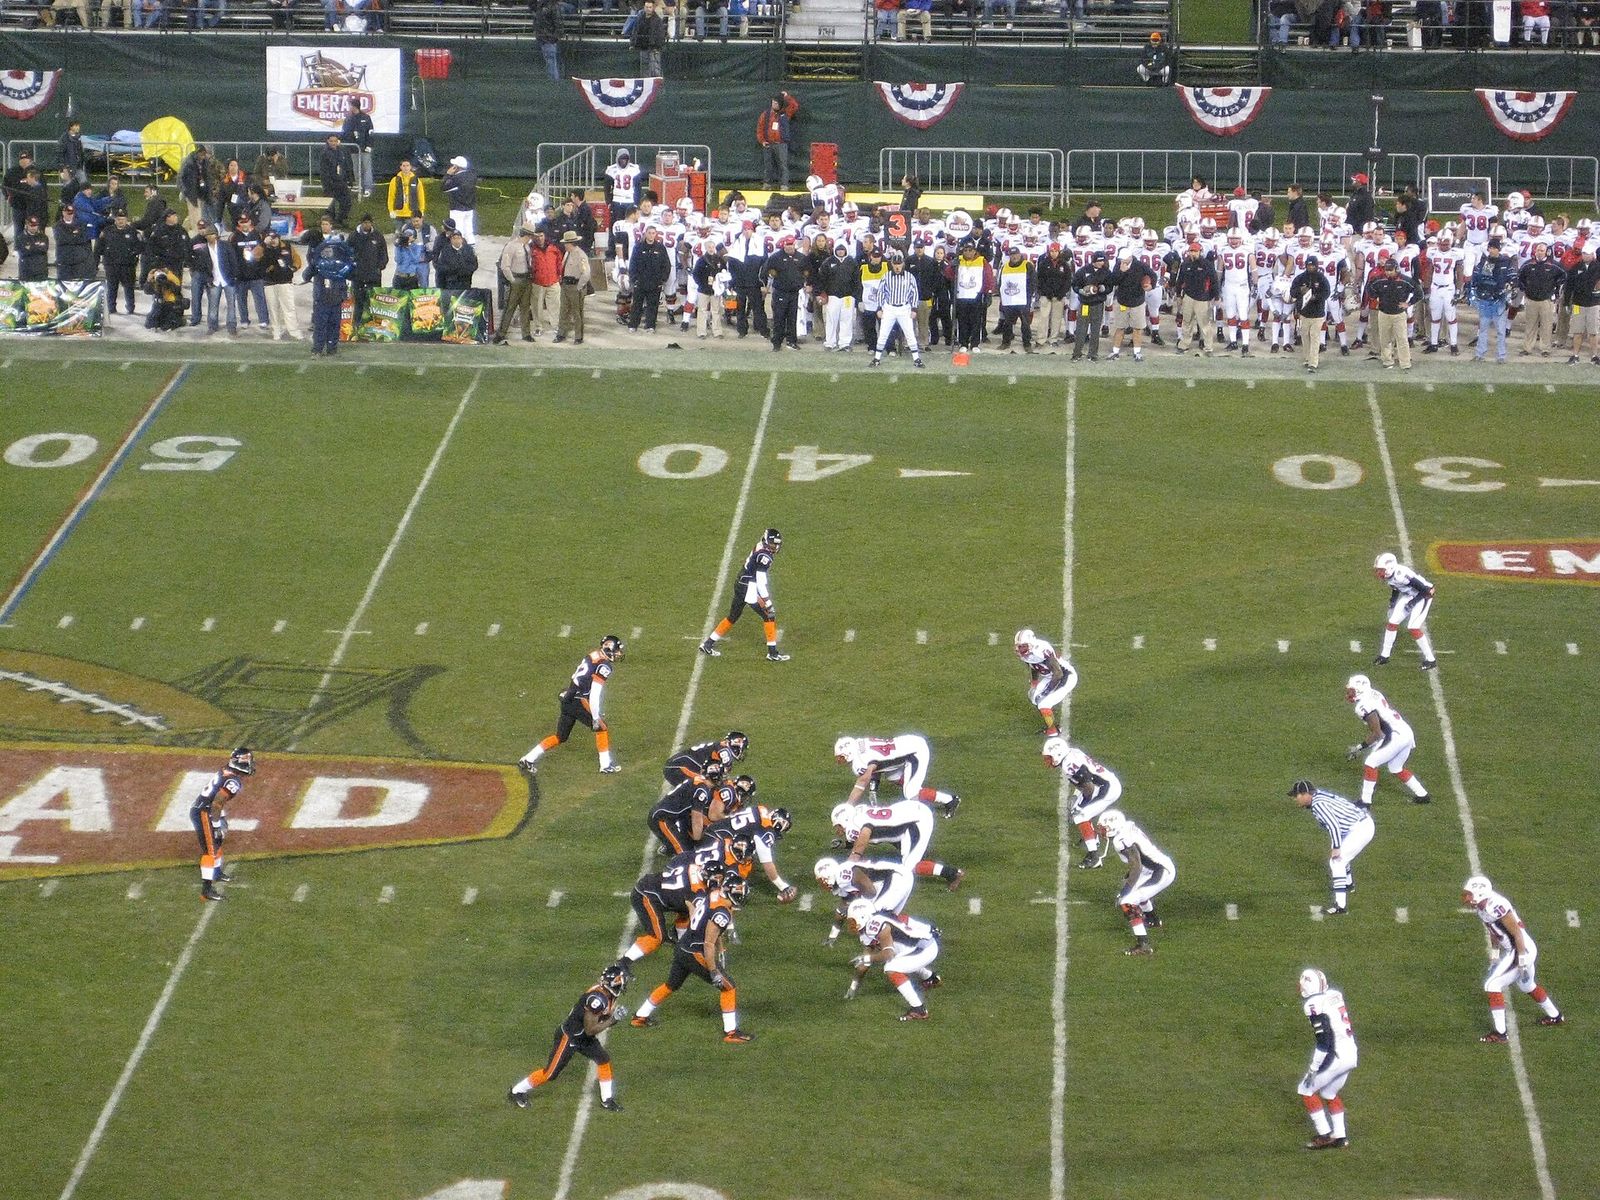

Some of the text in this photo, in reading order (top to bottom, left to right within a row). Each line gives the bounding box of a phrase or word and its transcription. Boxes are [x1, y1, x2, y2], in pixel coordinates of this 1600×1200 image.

[296, 94, 369, 112] EMERAD
[614, 174, 632, 191] 18
[888, 214, 907, 237] 3
[1466, 215, 1487, 231] 38
[912, 230, 933, 246] 76
[1223, 253, 1245, 270] 56
[1256, 251, 1276, 268] 29
[1433, 257, 1453, 274] 57
[225, 781, 240, 794] 26
[714, 914, 728, 928] 88
